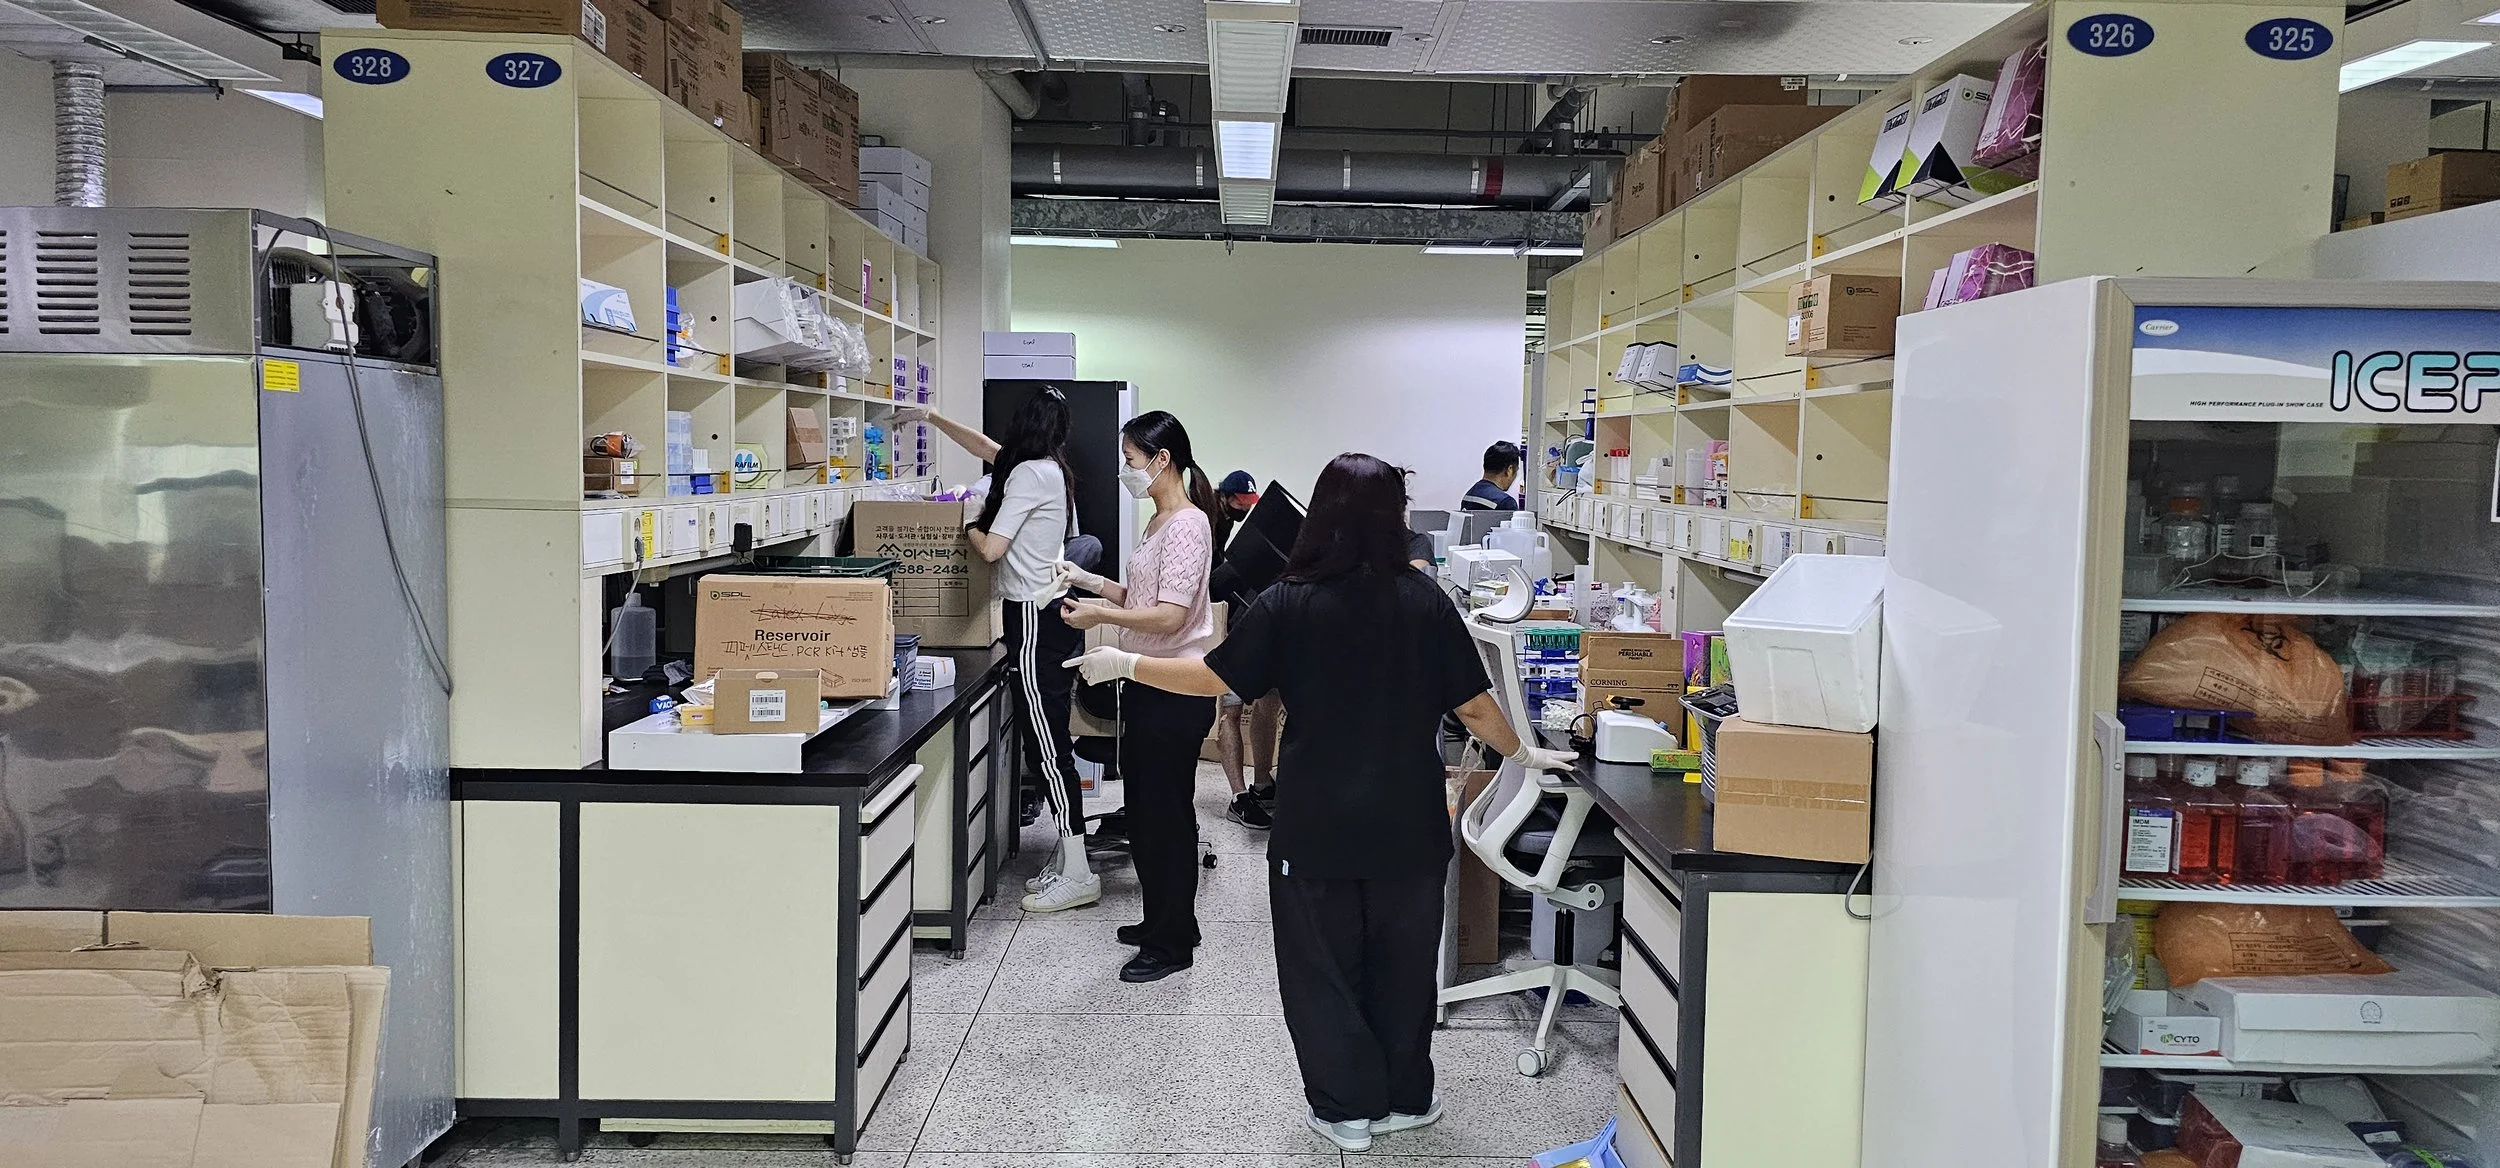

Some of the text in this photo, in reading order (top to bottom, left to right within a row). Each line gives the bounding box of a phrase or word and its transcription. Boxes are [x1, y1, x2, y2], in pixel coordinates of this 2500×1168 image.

[2089, 22, 2135, 48] 326
[2268, 26, 2315, 52] 325
[351, 55, 392, 78] 328
[504, 59, 545, 81] 327
[2145, 323, 2174, 332] Carrier
[735, 461, 759, 469] RAFILM
[1247, 480, 1256, 492] A
[754, 629, 831, 642] Reservoir
[796, 645, 820, 657] PCR
[1590, 679, 1628, 687] CORNING
